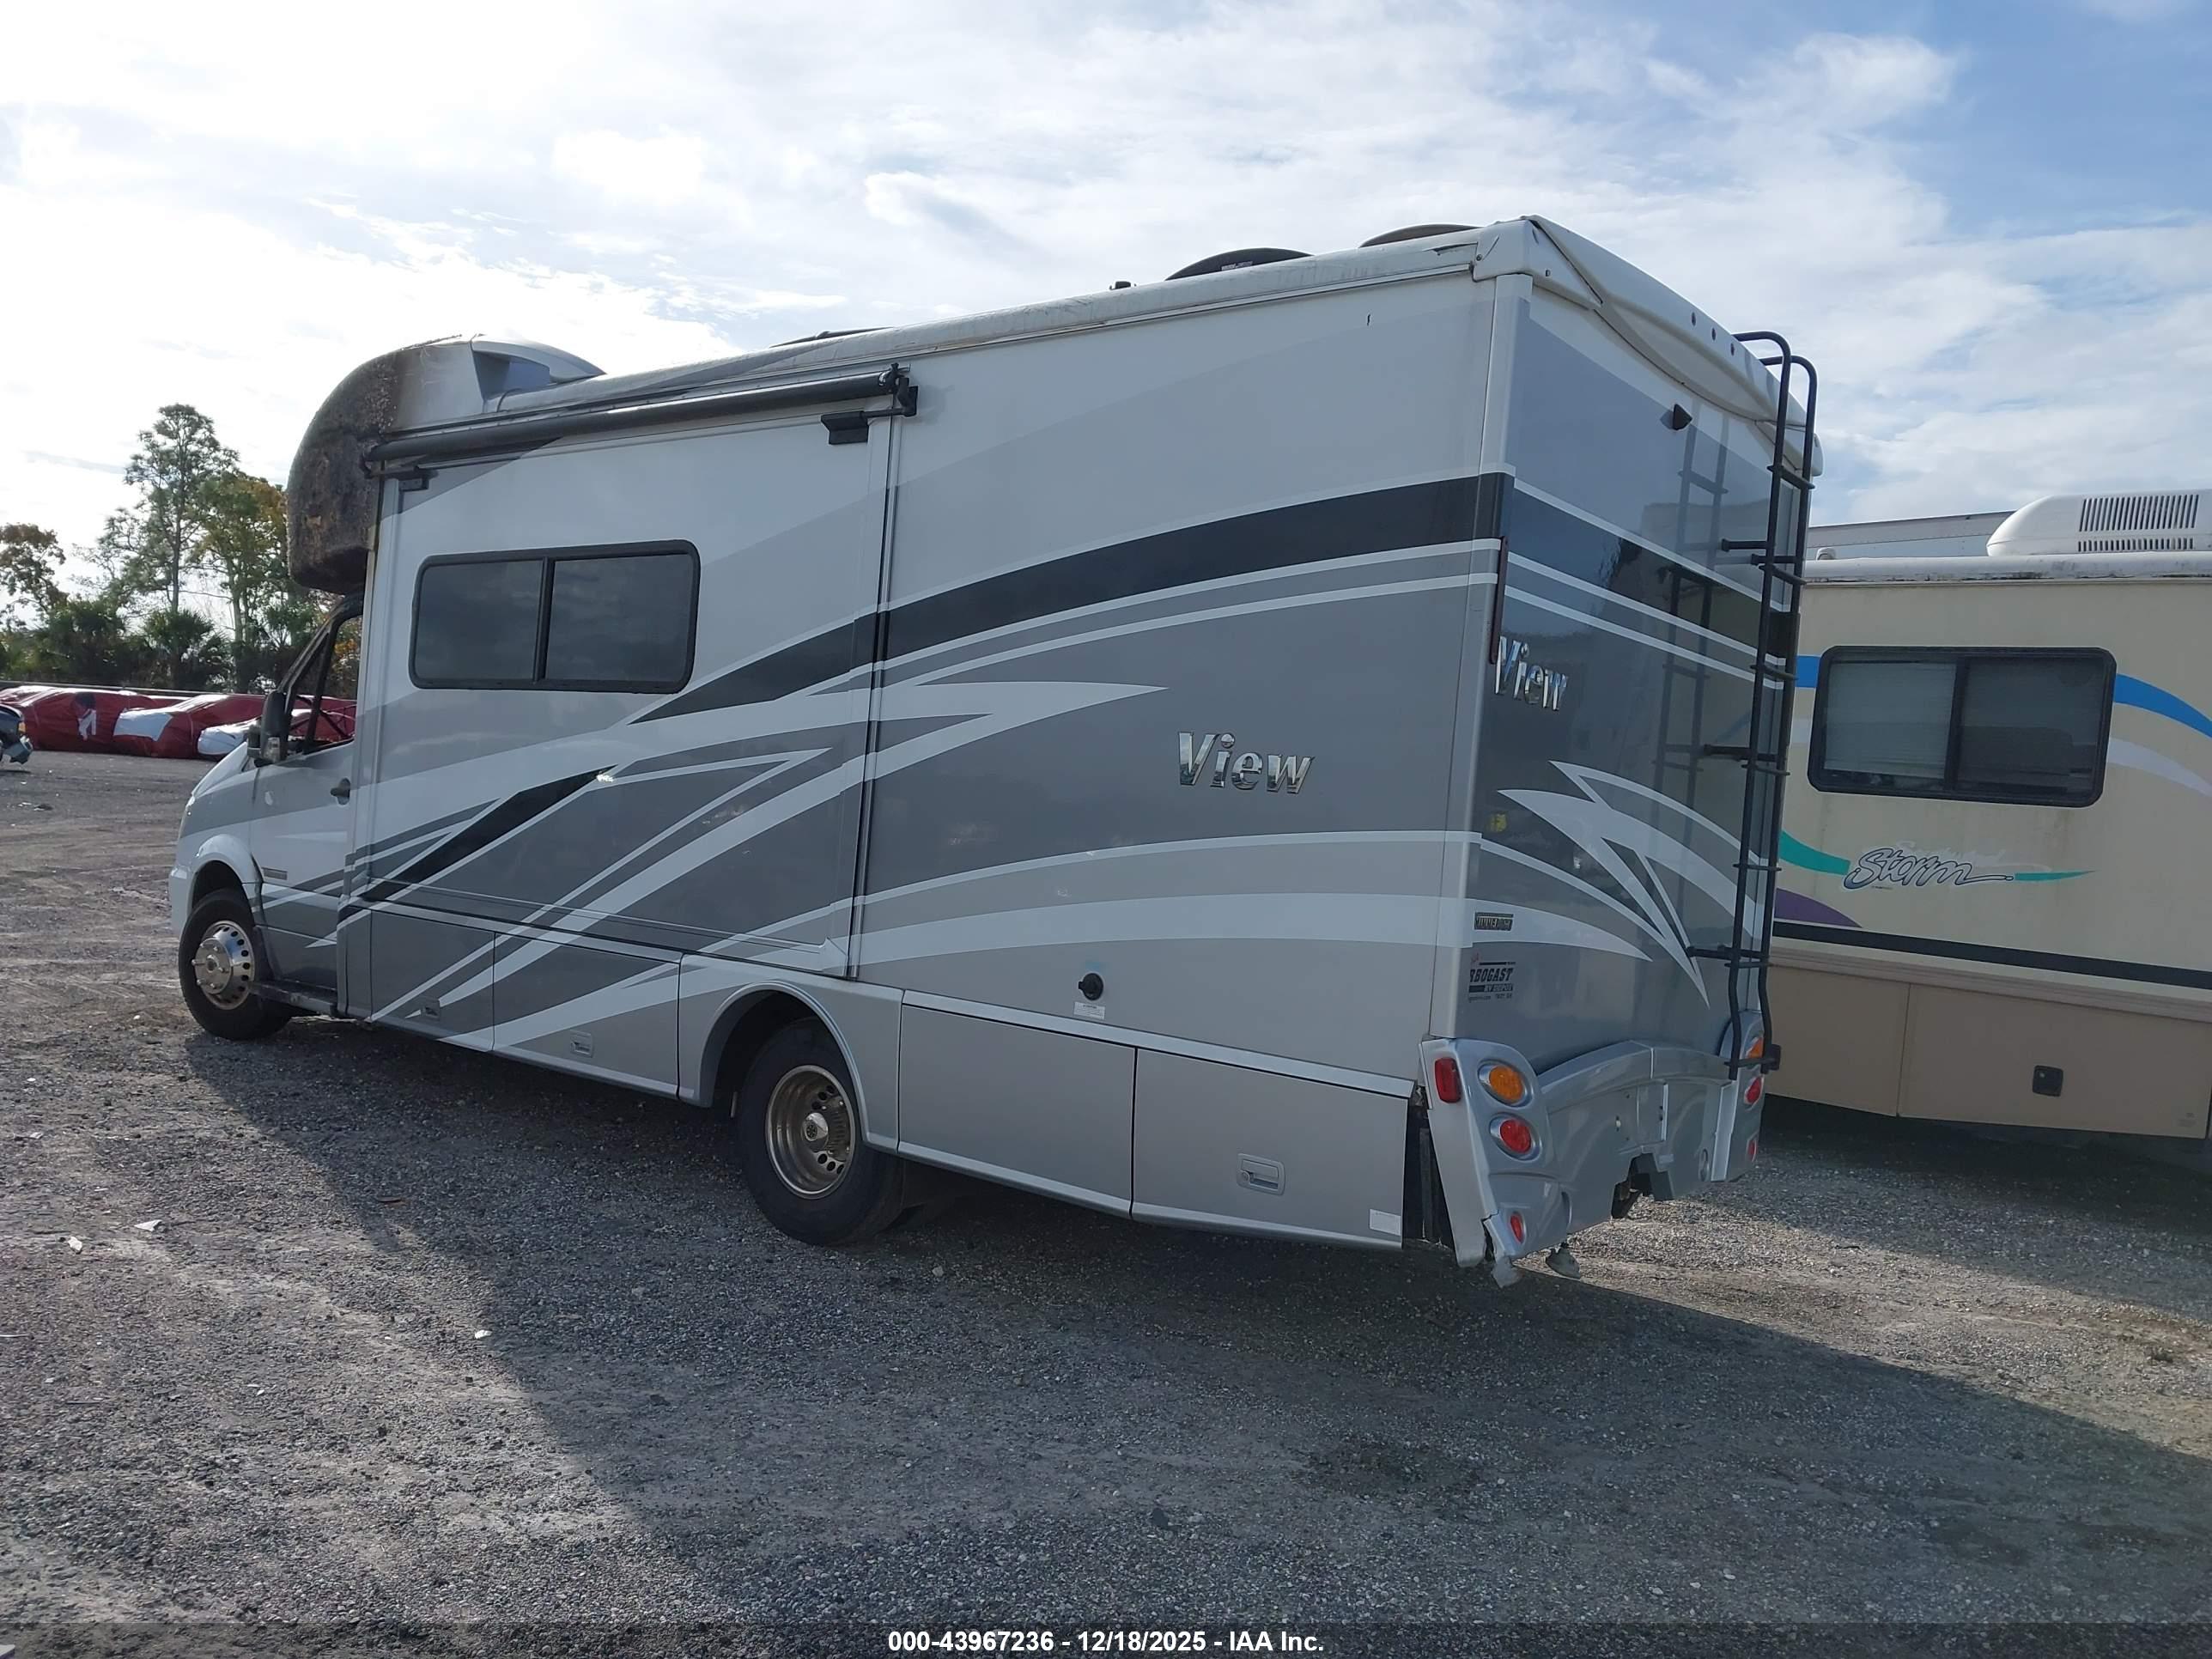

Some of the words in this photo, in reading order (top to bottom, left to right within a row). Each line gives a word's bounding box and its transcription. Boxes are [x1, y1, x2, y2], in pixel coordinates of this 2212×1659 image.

[1494, 635, 1569, 711] View
[1177, 732, 1316, 794] View
[1843, 848, 2014, 890] Storm
